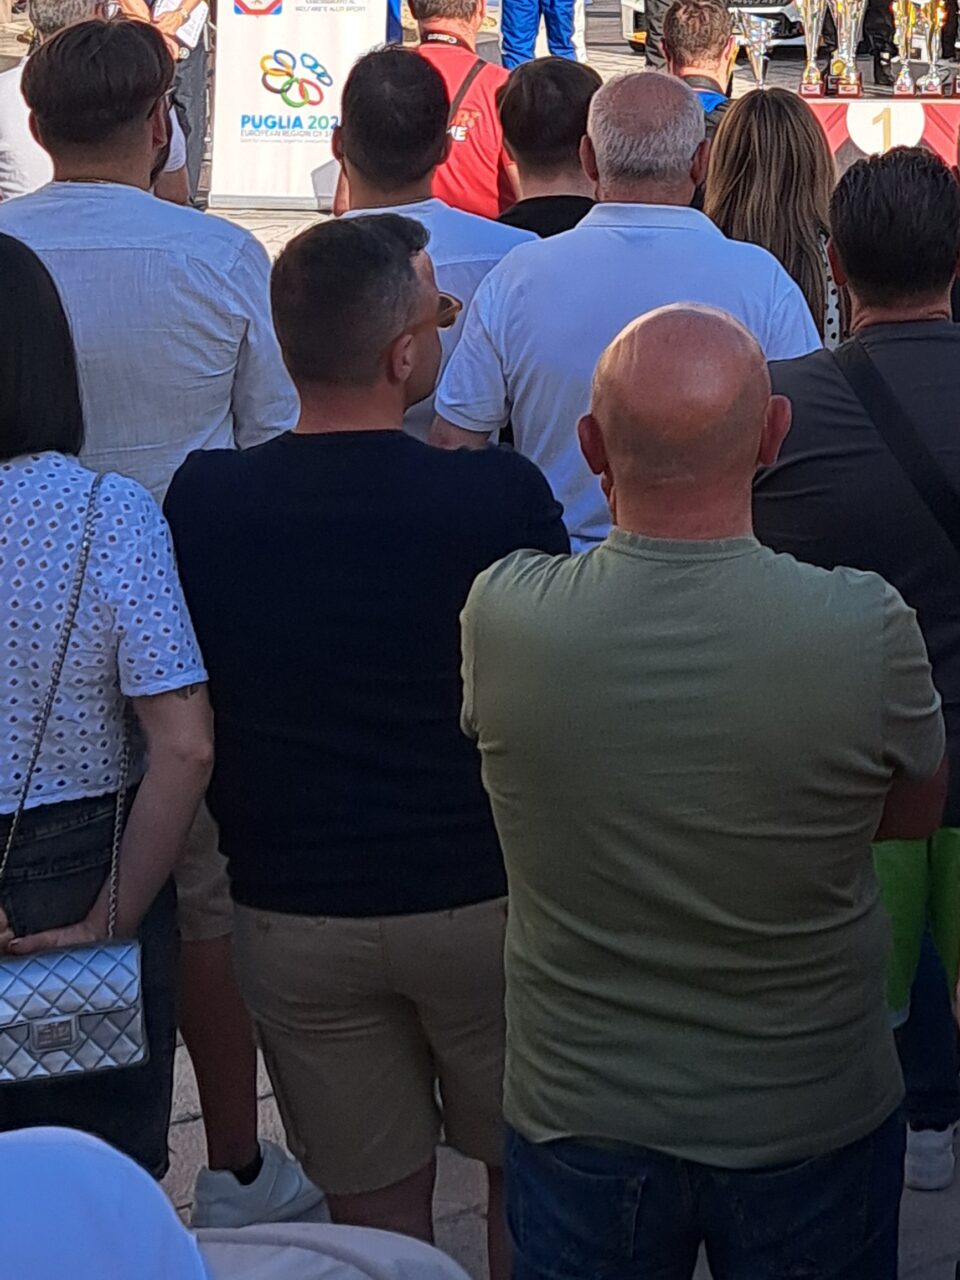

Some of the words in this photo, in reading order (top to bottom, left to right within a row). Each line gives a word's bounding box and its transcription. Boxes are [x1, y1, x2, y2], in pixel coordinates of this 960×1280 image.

[240, 114, 304, 130] PUGLIA
[307, 115, 340, 130] 202
[872, 106, 892, 154] 1
